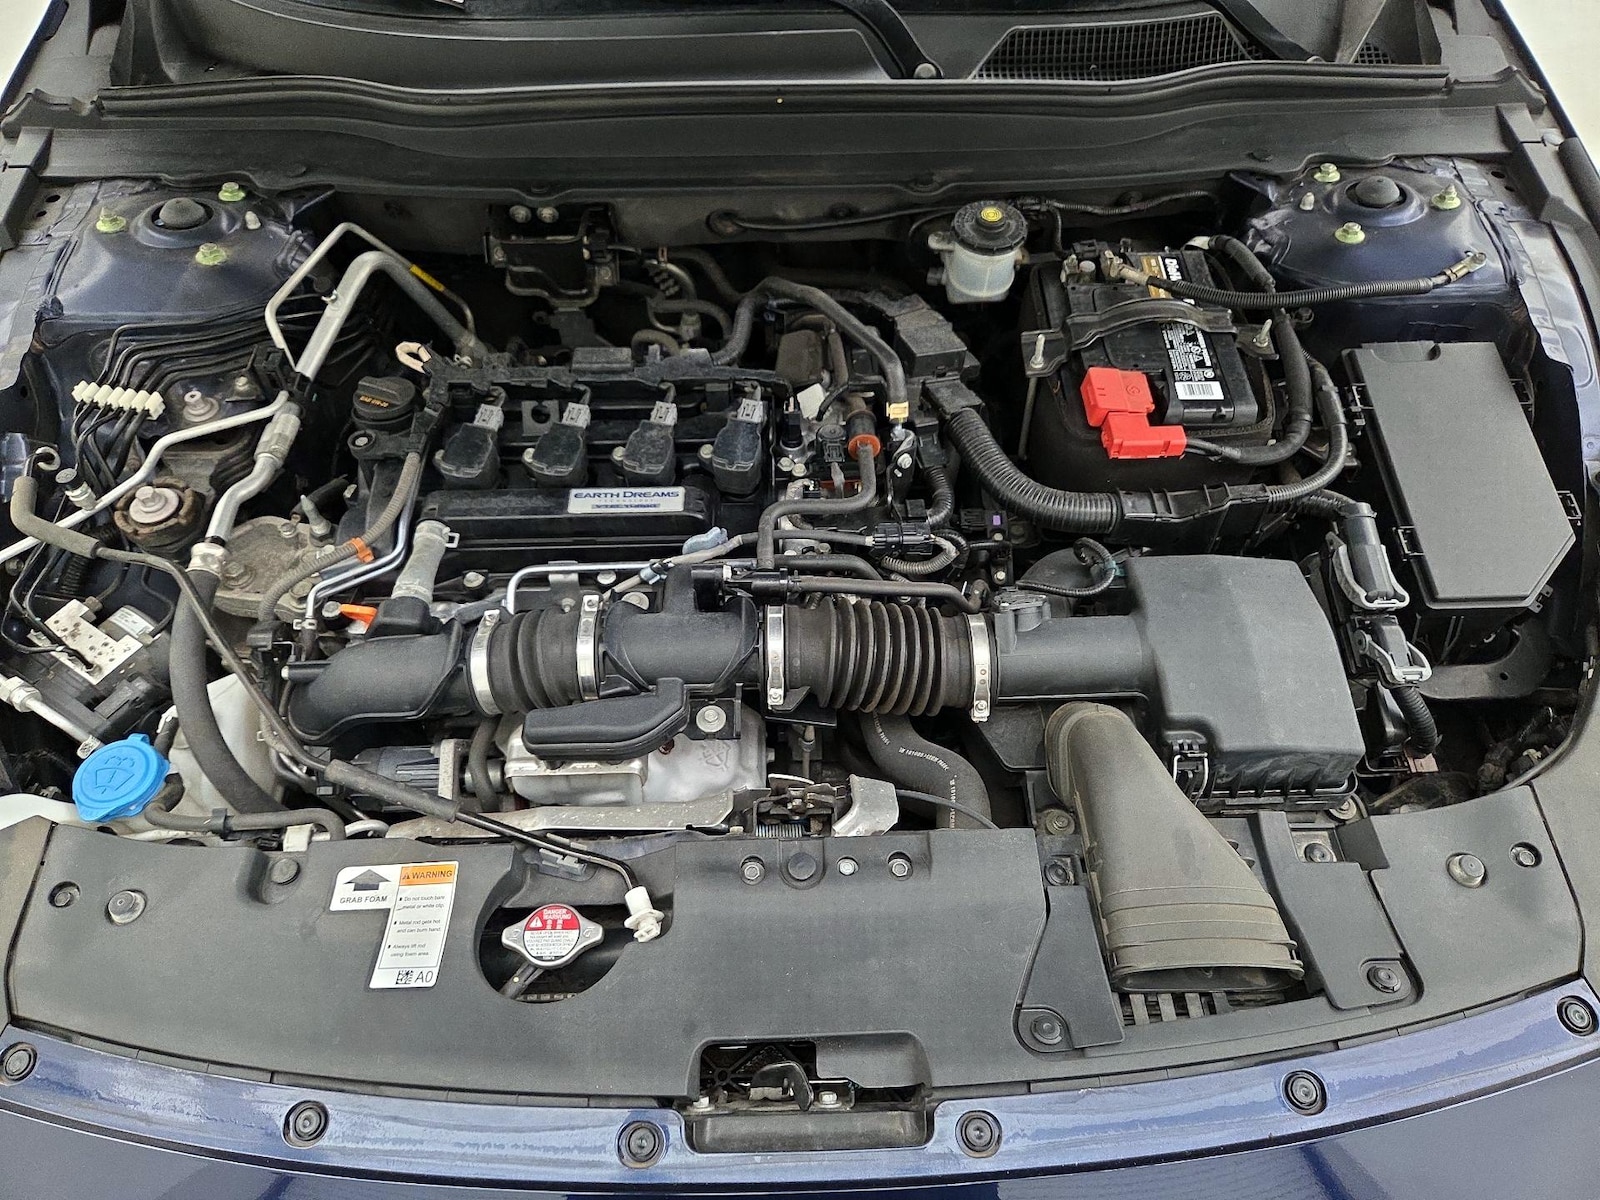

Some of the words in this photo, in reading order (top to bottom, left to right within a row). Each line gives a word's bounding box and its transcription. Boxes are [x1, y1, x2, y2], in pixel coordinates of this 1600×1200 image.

[411, 870, 453, 880] WARNING
[339, 896, 363, 904] GRAB
[365, 895, 388, 903] FOAM
[414, 970, 434, 983] A0
